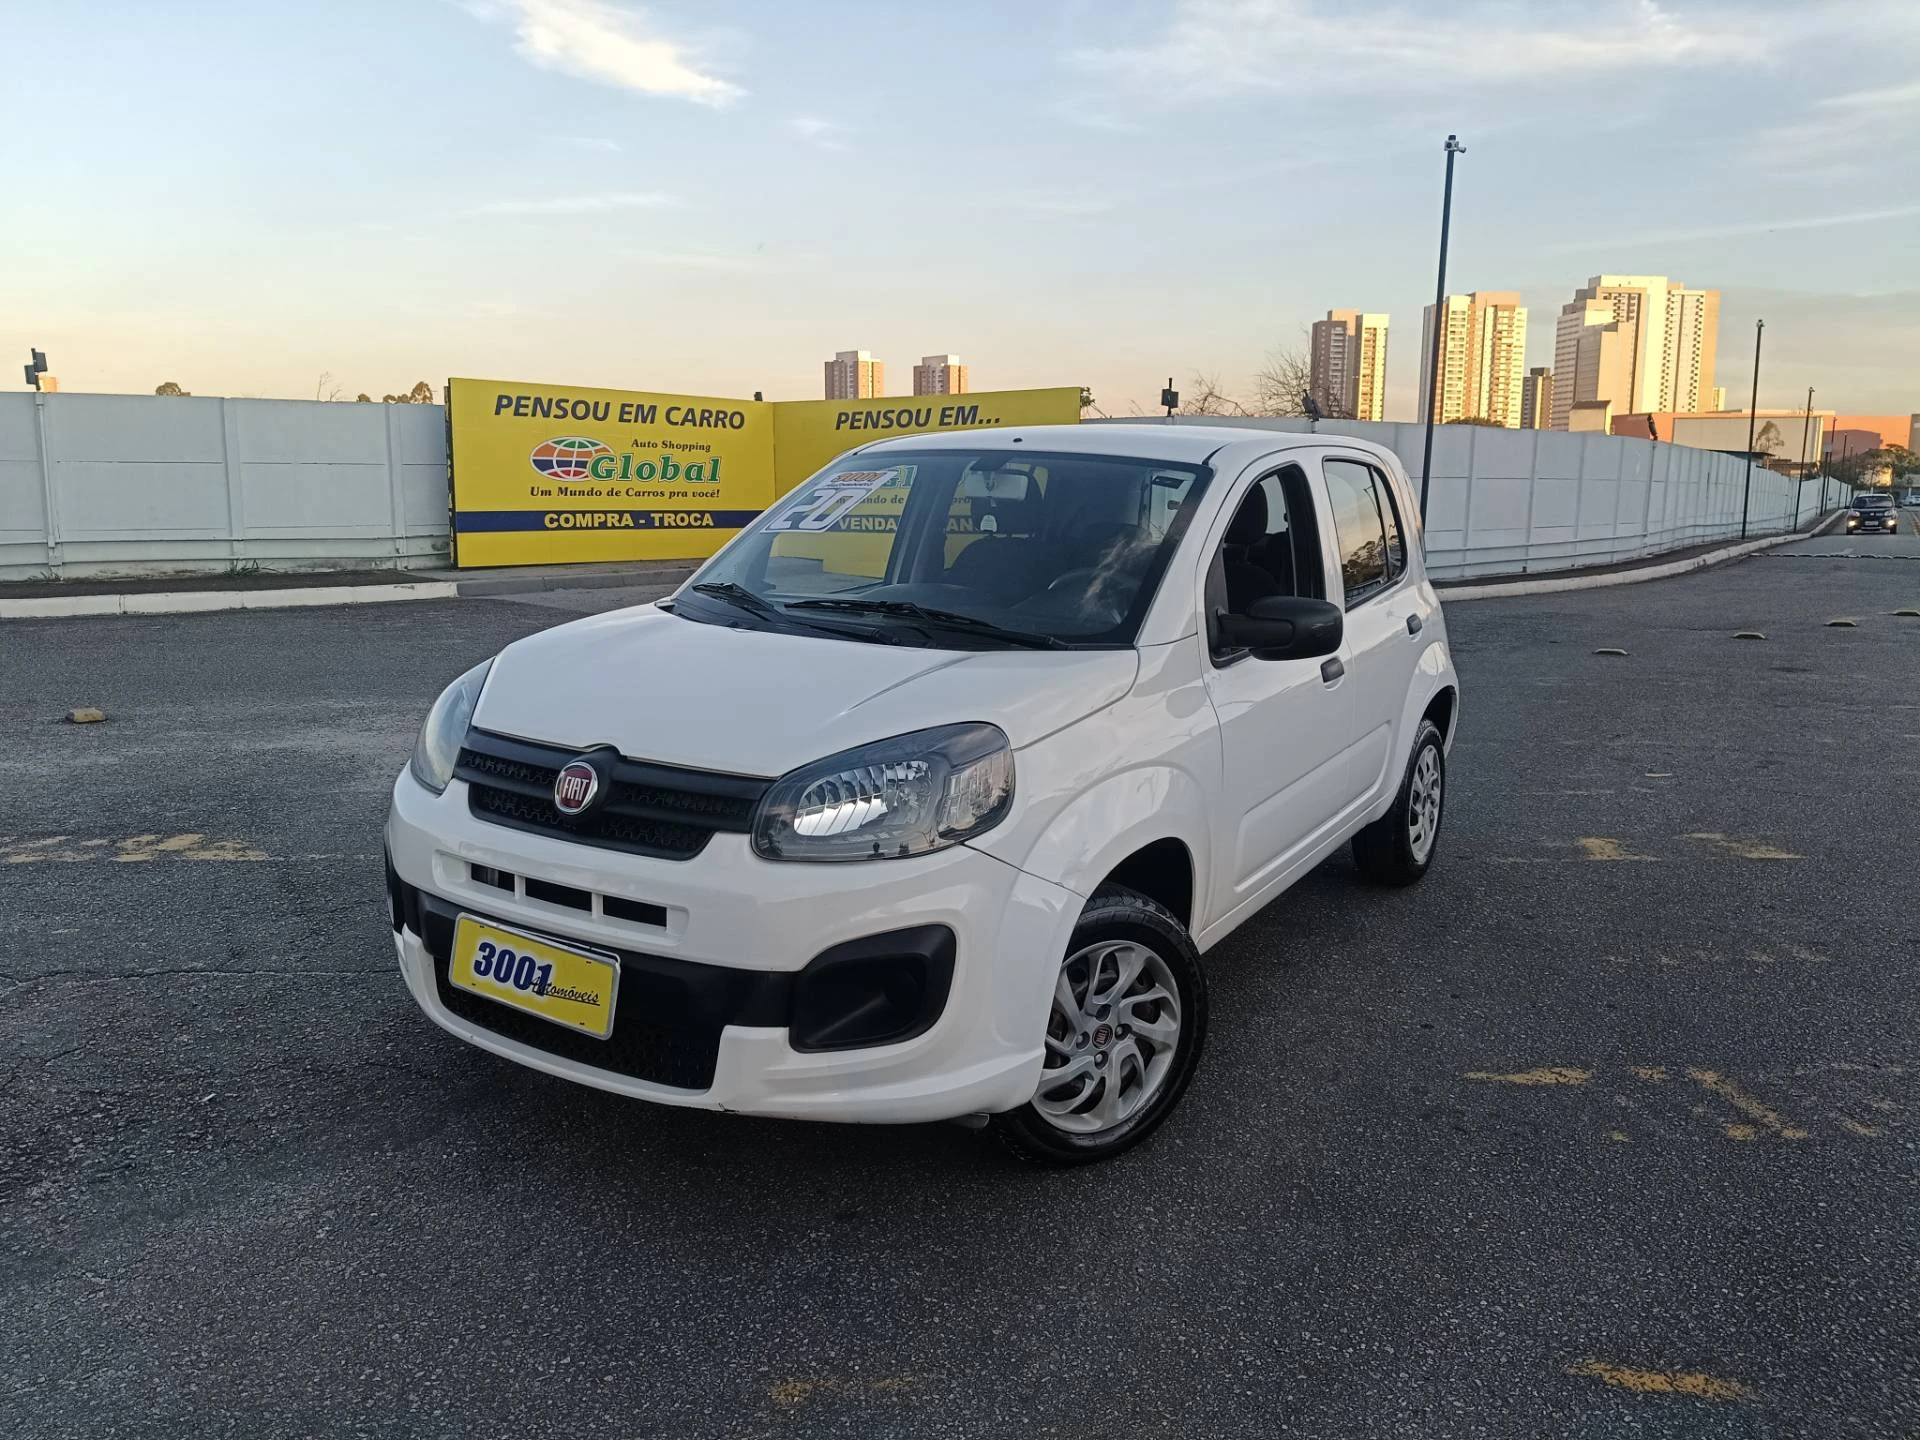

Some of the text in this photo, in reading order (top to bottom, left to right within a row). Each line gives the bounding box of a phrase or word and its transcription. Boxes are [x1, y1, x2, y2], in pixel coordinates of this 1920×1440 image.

[494, 394, 745, 430] PENSOU EM CARRO
[835, 404, 1001, 430] PENSOU EM...
[631, 439, 711, 453] Auto Shopping
[589, 452, 722, 483] Global
[530, 486, 720, 500] Um Mundo de Carros pra você!
[544, 513, 634, 529] COMPRA
[650, 512, 714, 527] TROCA
[767, 488, 874, 530] 20
[839, 517, 897, 531] VENDA
[562, 776, 590, 801] FIAT
[473, 941, 553, 997] 3001
